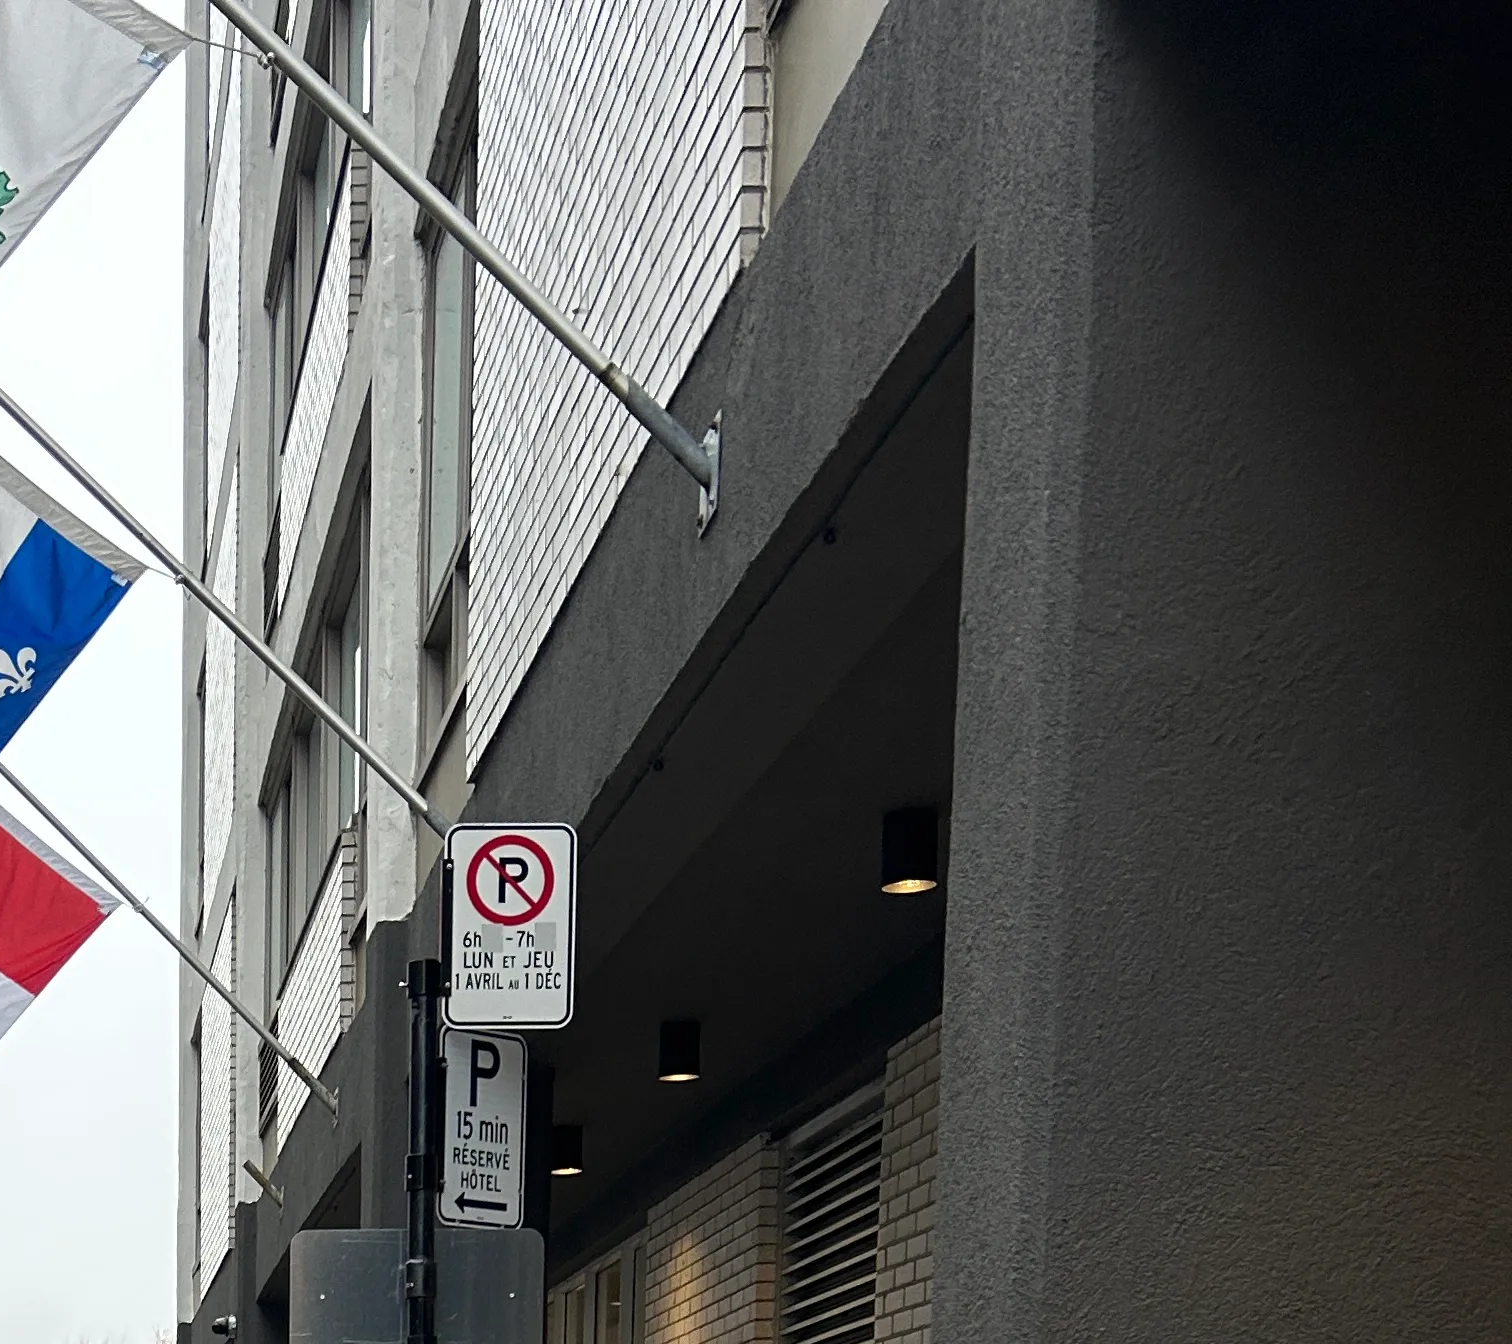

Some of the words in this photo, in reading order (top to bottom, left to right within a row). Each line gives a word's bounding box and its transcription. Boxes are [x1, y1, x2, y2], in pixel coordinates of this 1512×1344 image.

[463, 931, 481, 948] 6h
[463, 952, 494, 968] LUN
[502, 956, 516, 968] ET
[523, 951, 554, 968] JEU
[455, 973, 460, 989] 1
[465, 973, 503, 989] AVRIL
[508, 980, 519, 989] AU
[525, 973, 529, 989] 1
[536, 969, 562, 989] DÉC
[470, 1039, 500, 1107] P
[457, 1110, 473, 1140] 15
[479, 1116, 508, 1145] min
[453, 1143, 510, 1170] RÉSERVÉ
[460, 1169, 502, 1192] HÔTEL
